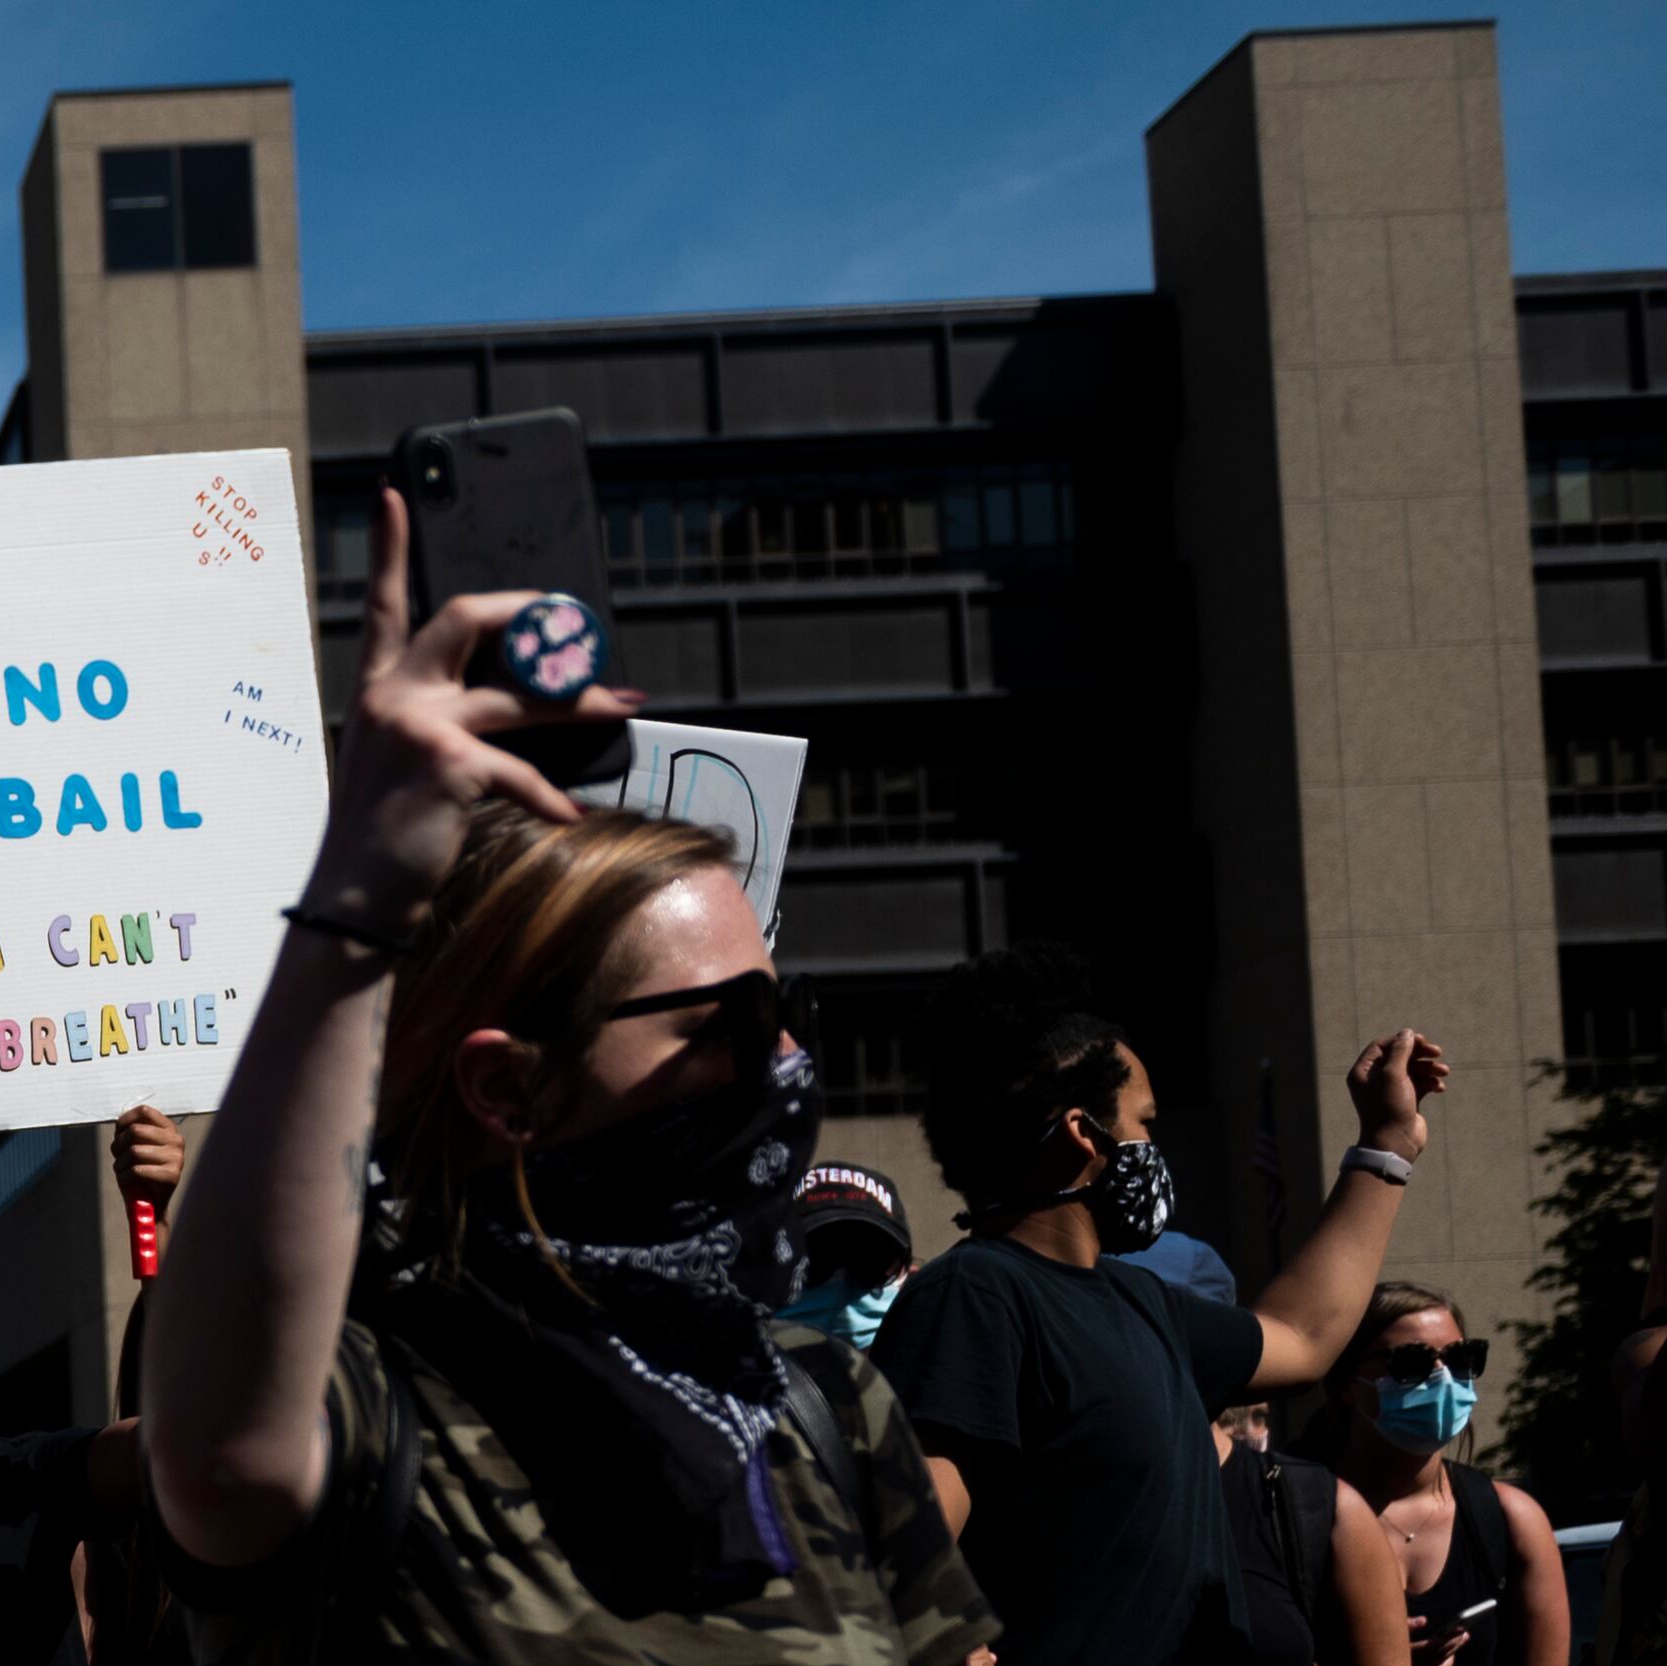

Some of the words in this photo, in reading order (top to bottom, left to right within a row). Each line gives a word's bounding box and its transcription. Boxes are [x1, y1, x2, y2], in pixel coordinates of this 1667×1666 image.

[211, 475, 259, 520] STOP
[194, 489, 265, 562] KILLING
[3, 659, 129, 726] NO
[232, 680, 264, 702] AM
[224, 709, 233, 726] I
[241, 714, 304, 755] NEXT!
[47, 909, 198, 969] CAN'T
